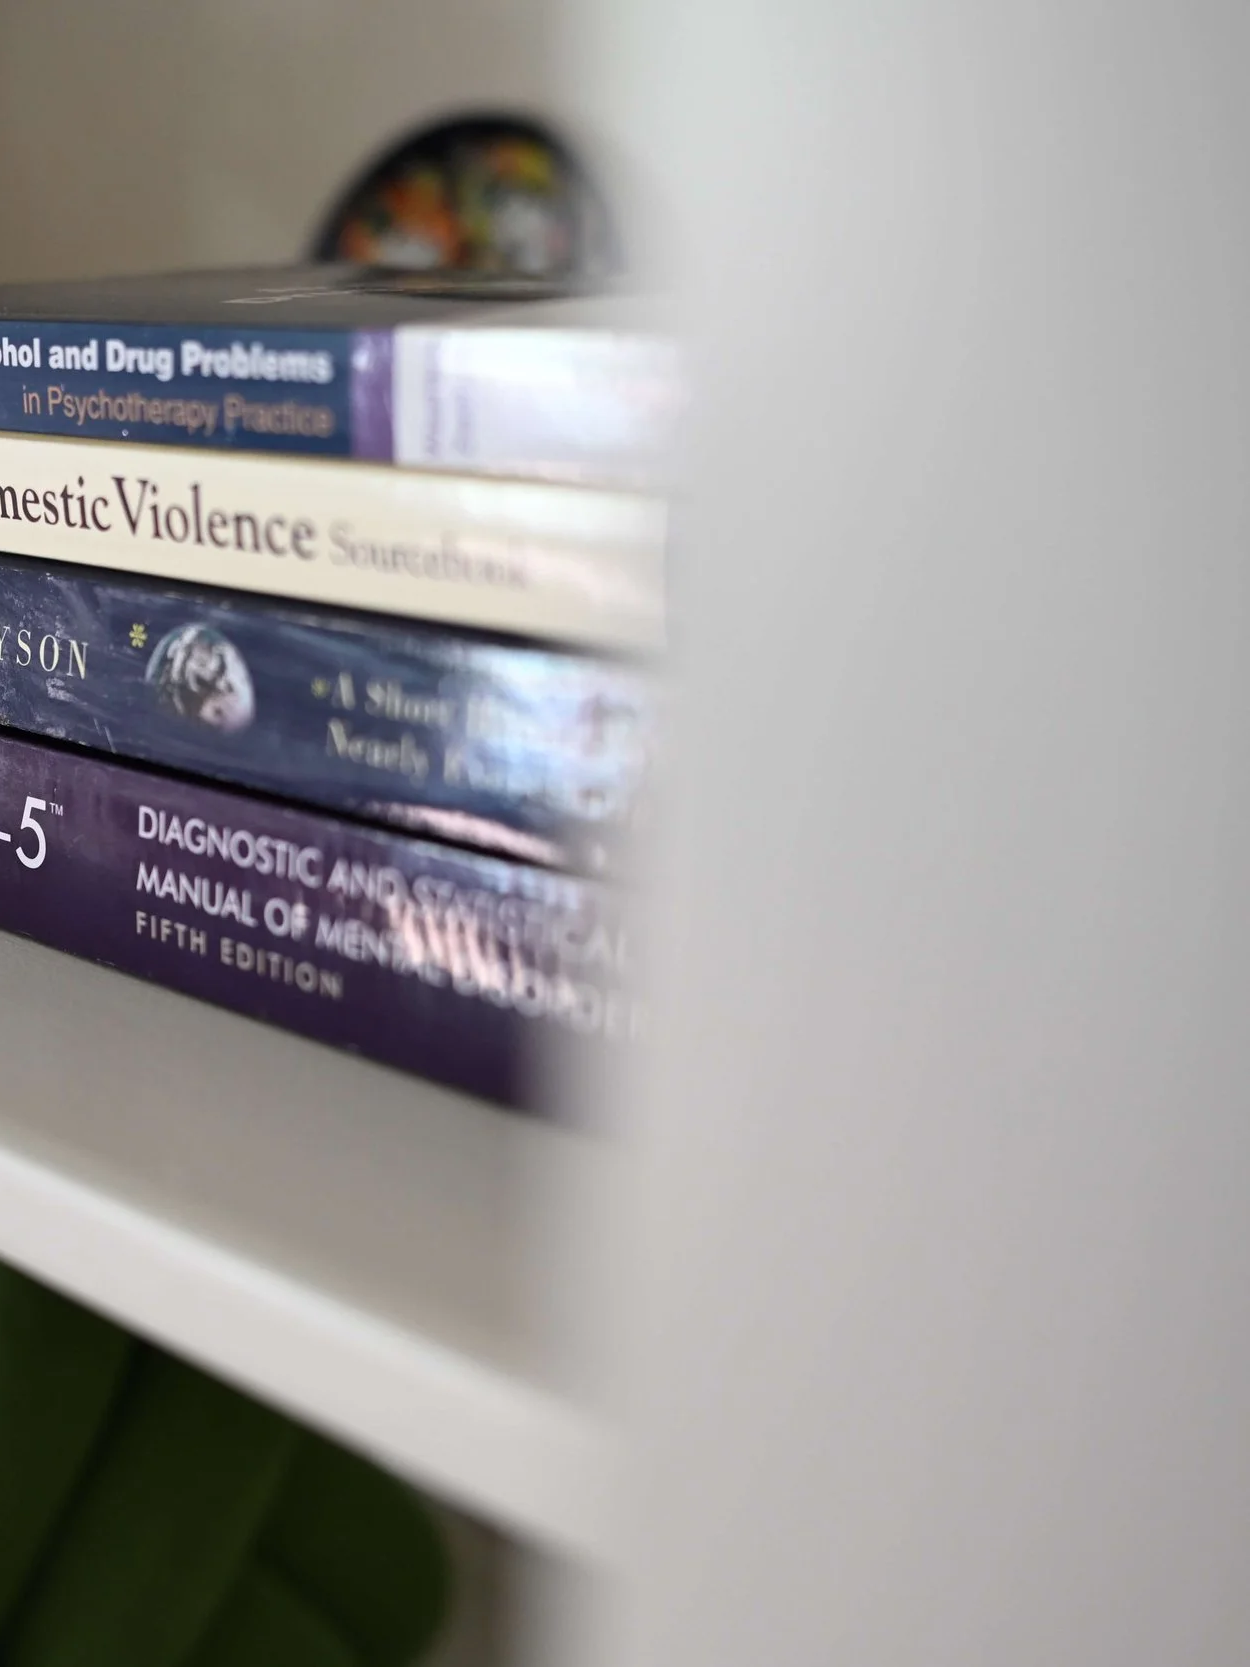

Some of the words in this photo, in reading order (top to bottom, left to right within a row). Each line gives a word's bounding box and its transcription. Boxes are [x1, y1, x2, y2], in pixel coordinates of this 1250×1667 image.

[48, 341, 99, 373] and
[106, 340, 174, 382] Drug
[181, 341, 335, 385] Problems
[22, 386, 42, 415] in
[47, 385, 217, 436] Psychotherapy
[224, 393, 336, 438] Practice
[111, 475, 316, 561] Violence
[138, 804, 323, 888] DIAGNOSTIC
[326, 858, 406, 904] AND
[136, 862, 258, 929] MANUAL
[263, 898, 310, 940] OF
[135, 910, 207, 955] FIFTH
[219, 936, 345, 1000] EDITION
